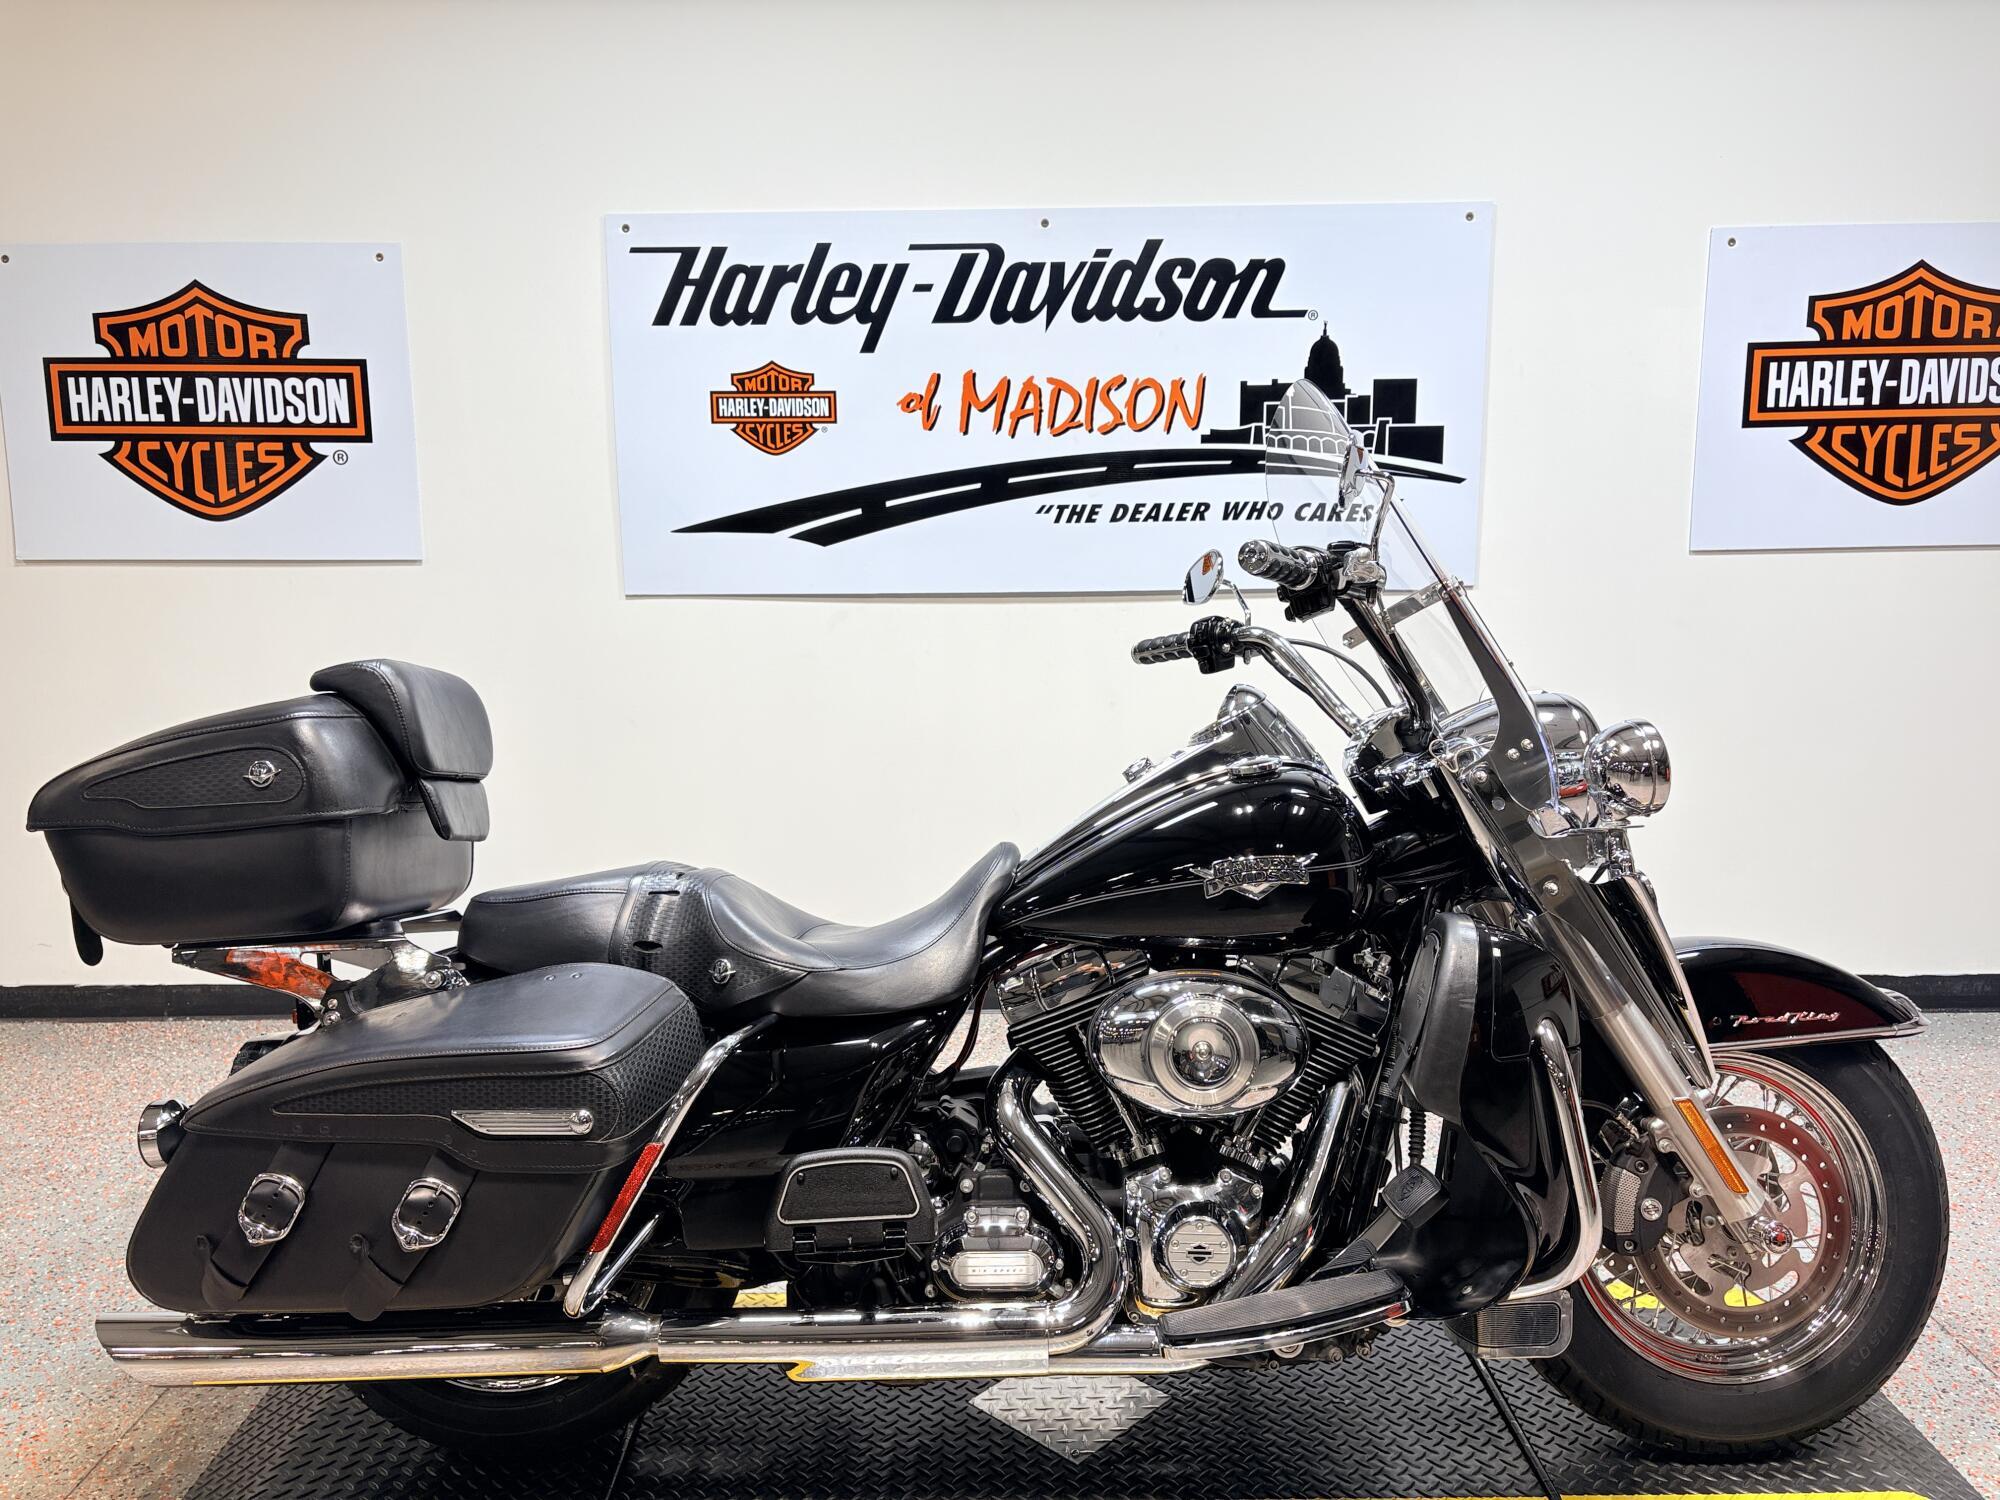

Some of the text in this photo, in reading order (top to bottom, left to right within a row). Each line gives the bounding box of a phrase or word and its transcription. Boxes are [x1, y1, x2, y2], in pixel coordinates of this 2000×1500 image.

[629, 238, 1309, 354] Harley-Davidson
[1841, 283, 1993, 341] MOTOR
[127, 303, 278, 359] MOTOR
[67, 376, 351, 424] HARLEY-DAVIDSON
[718, 397, 830, 417] HARLEY-DAVIDSON
[744, 369, 803, 392] MOTOR
[897, 369, 1207, 439] of MADISON
[744, 423, 804, 449] CYCLES
[1831, 423, 1982, 488] CYCLES
[137, 441, 286, 504] CYCLES
[1109, 502, 1211, 523] DEALER
[1222, 502, 1285, 521] WHO
